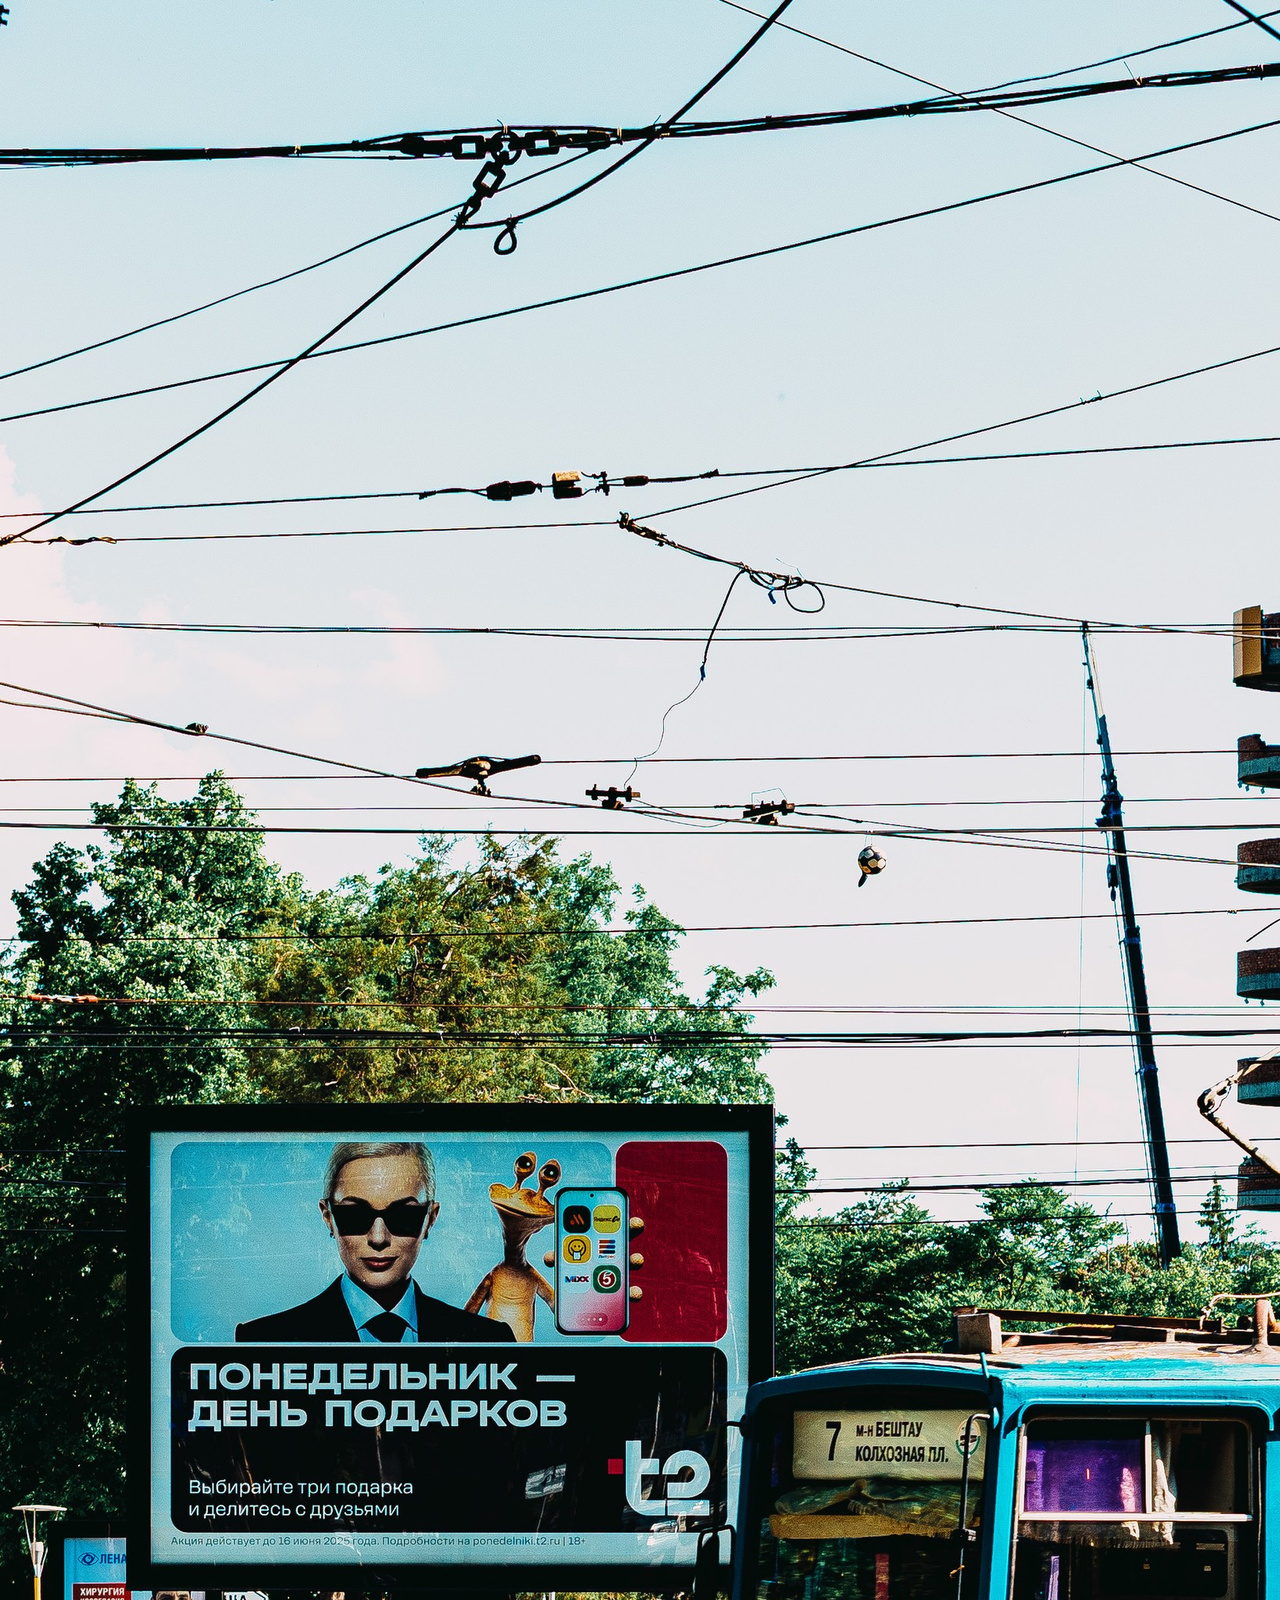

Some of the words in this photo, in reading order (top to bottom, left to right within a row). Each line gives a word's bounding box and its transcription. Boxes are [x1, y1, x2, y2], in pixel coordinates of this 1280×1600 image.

[190, 1362, 518, 1395] ПОНЕДЕЛЬНИК
[187, 1399, 308, 1432] ДЕНЬ
[324, 1399, 568, 1432] ПОДАРКОВ
[875, 1421, 924, 1438] БЕШТАУ
[825, 1420, 842, 1462] 7
[855, 1445, 926, 1463] КОЛХОЗНАЯ
[927, 1446, 949, 1463] ПЛ.
[625, 1440, 711, 1516] t2
[189, 1478, 294, 1498] Выбирайте
[297, 1482, 330, 1498] три
[335, 1482, 414, 1498] подарка
[188, 1504, 200, 1517] и
[203, 1504, 292, 1519] делитесь
[295, 1504, 306, 1517] с
[309, 1504, 400, 1520] друзьями
[171, 1536, 204, 1547] Акция
[205, 1535, 261, 1548] действует
[262, 1537, 276, 1547] до
[278, 1536, 291, 1546] 16
[293, 1537, 321, 1546] июня
[323, 1536, 351, 1546] 2025
[352, 1537, 380, 1547] года.
[382, 1536, 455, 1547] Подробности
[457, 1537, 471, 1546] на
[472, 1535, 561, 1547] ponedelniki.t2.ru
[568, 1536, 586, 1546] 18+
[99, 1553, 127, 1565] ЛЕНА
[80, 1587, 125, 1596] ХИРУРГИЯ
